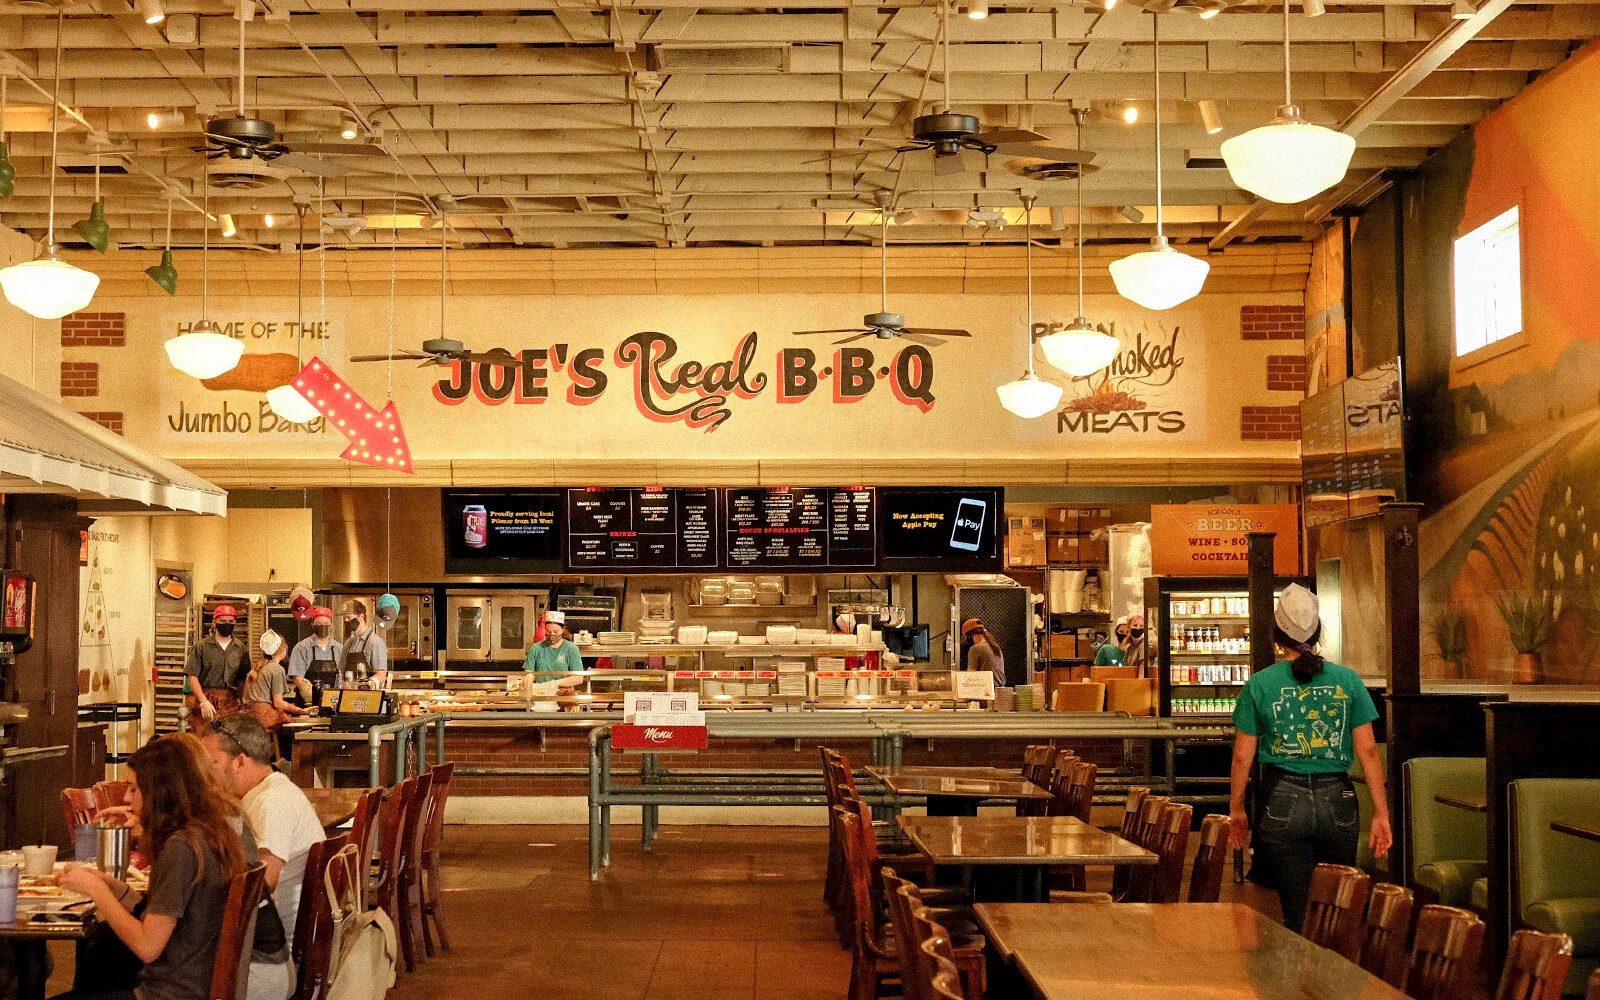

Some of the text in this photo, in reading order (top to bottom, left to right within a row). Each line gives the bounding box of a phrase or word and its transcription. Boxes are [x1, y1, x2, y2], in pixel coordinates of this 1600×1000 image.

[177, 321, 331, 339] HME OF THE
[1030, 321, 1116, 344] PEN
[432, 343, 608, 406] JOE'S
[614, 331, 767, 434] Real
[168, 400, 252, 434] Jumbo
[1057, 410, 1186, 434] MEATS
[910, 512, 944, 520] Accepting
[902, 521, 921, 529] Apple
[964, 519, 981, 531] Pay
[1196, 518, 1253, 531] BEER
[1188, 538, 1221, 546] WINE
[643, 727, 673, 743] Menu
